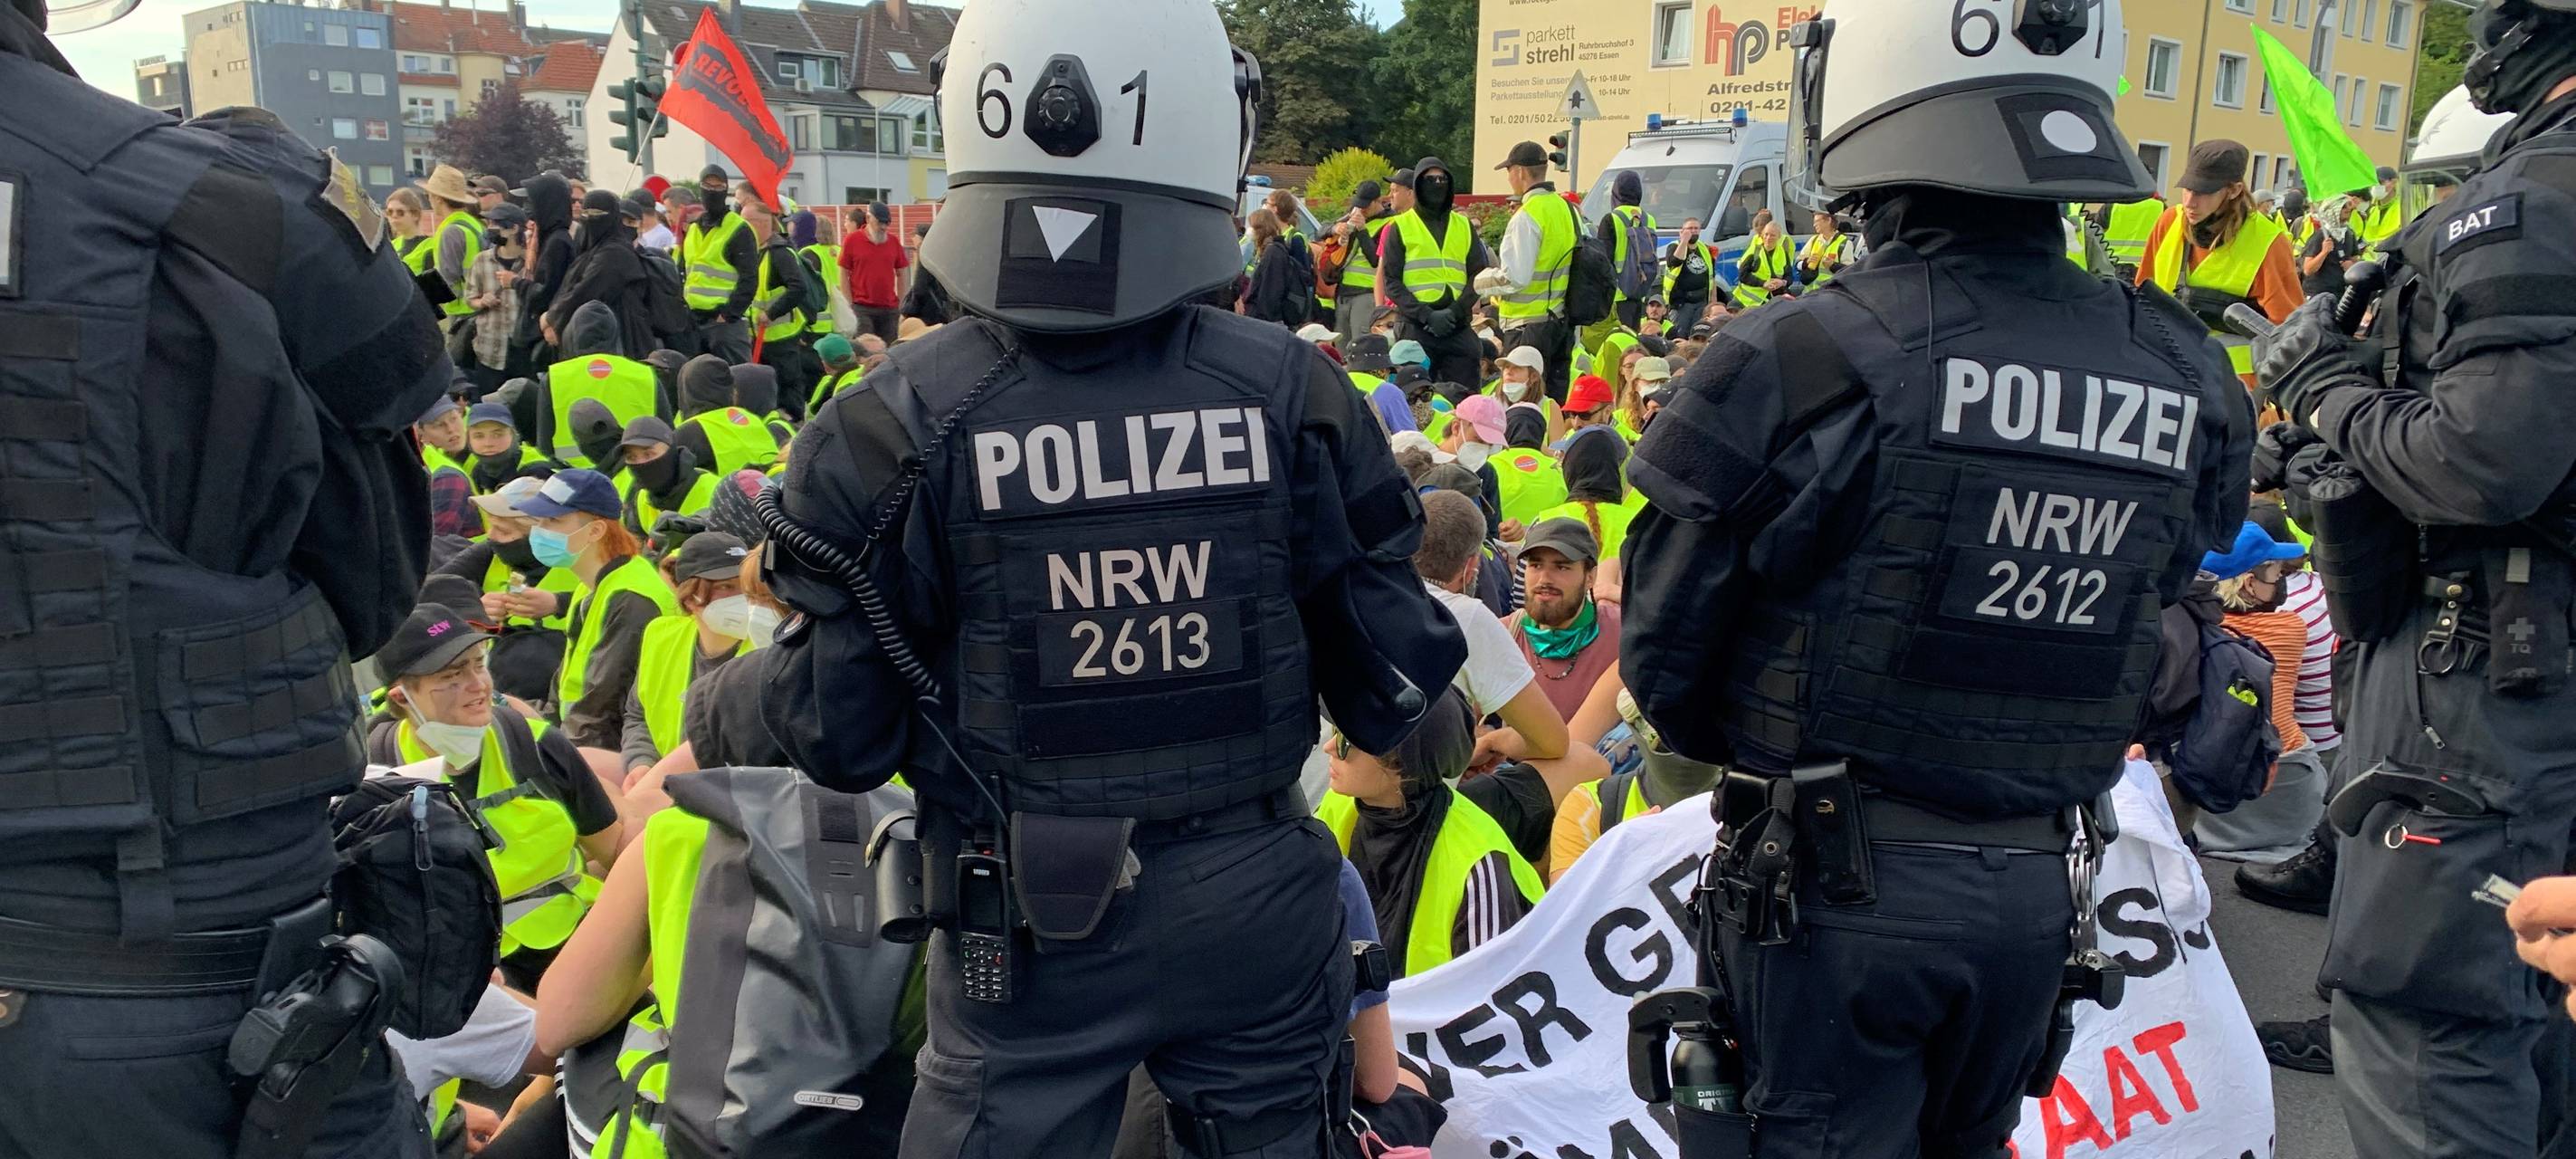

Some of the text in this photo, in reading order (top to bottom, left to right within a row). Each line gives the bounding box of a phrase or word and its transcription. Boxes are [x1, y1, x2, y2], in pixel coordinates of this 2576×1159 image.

[1526, 24, 1576, 47] parkett
[1579, 40, 1628, 50] Ruhrbruchshof
[1951, 0, 2001, 57] 6
[1526, 43, 1575, 64] strehl
[1598, 52, 1619, 60] Essen
[976, 62, 1148, 146] 6 1
[1492, 77, 1530, 88] Besuchen
[1531, 76, 1544, 85] Sie
[1617, 87, 1631, 95] Uhr
[1490, 115, 1506, 124] Tel.
[2448, 206, 2498, 242] BAT
[1942, 357, 2199, 471] POLIZEI
[974, 406, 1271, 511] POLIZEI
[1986, 487, 2139, 556] NRW
[1047, 540, 1212, 610] NRW
[1975, 560, 2107, 625] 2612
[1070, 612, 1211, 678] 2613
[2509, 643, 2532, 655] TQ
[2006, 1021, 2199, 1159] AAT
